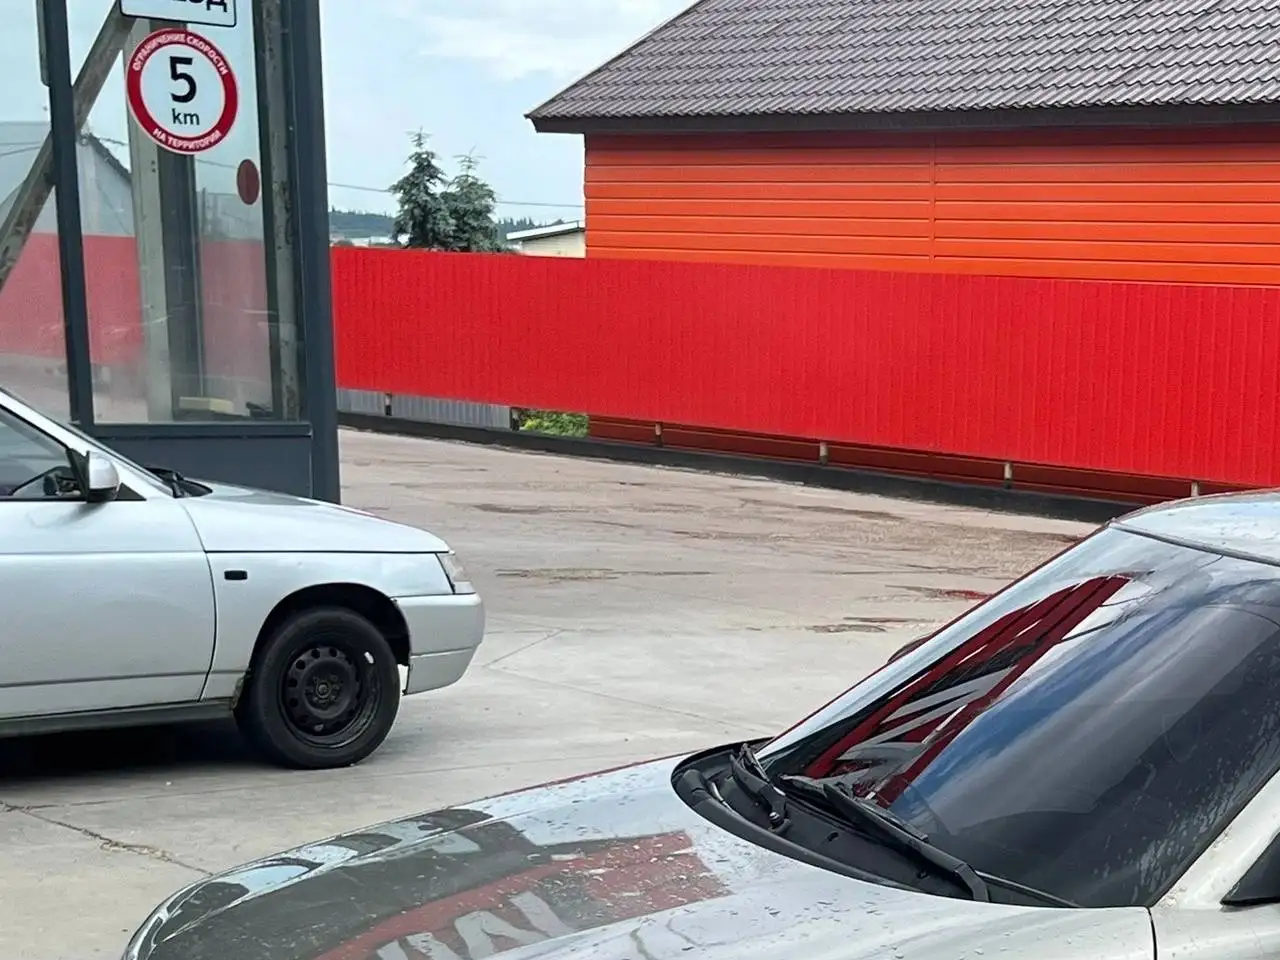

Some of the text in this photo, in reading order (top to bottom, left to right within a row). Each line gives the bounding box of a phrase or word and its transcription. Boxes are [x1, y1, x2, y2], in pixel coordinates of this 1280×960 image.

[132, 33, 229, 75] ОГРАНИЧЕНИЕ СКОРОСТИ
[169, 56, 197, 103] 5
[171, 108, 200, 125] km
[152, 128, 222, 149] НА ТЕРРИТОРИИ
